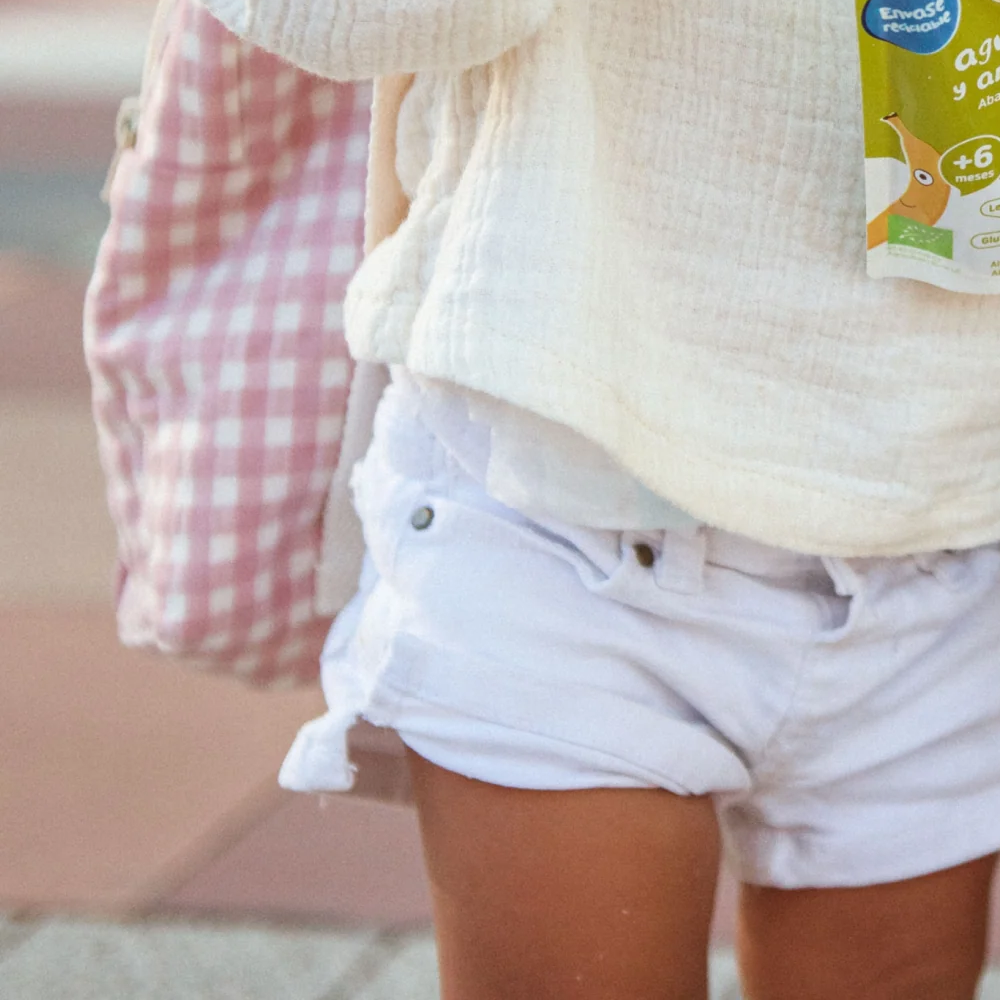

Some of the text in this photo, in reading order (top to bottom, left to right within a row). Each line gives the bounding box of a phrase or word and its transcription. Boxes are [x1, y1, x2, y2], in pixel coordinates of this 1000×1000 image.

[952, 81, 967, 101] y
[952, 144, 994, 170] +6
[955, 169, 995, 183] meses
